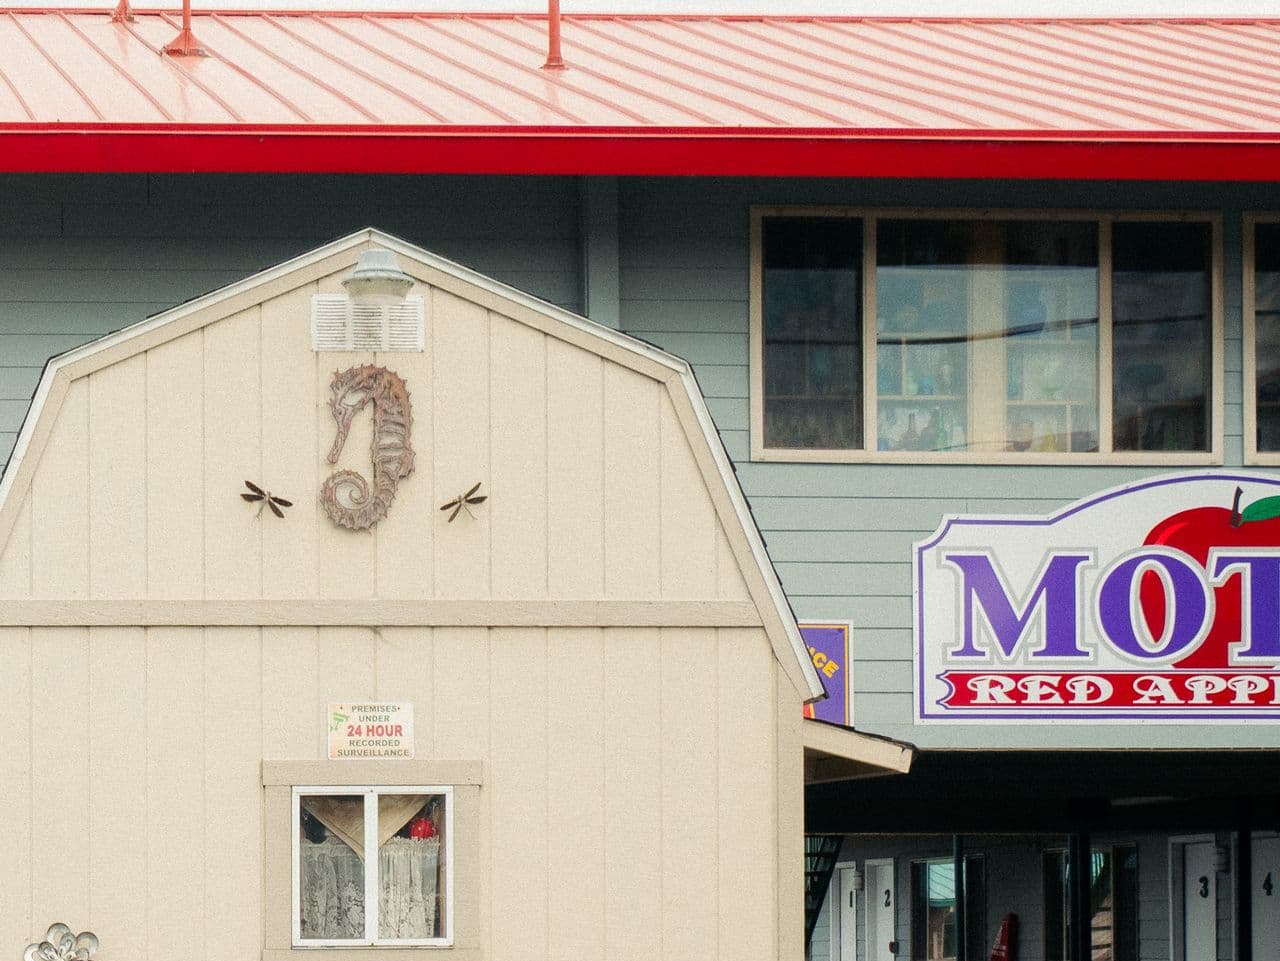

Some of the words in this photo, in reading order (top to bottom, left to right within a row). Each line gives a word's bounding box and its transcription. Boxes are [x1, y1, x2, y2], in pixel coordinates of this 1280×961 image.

[809, 647, 840, 679] CE
[966, 674, 1114, 705] RED
[1132, 674, 1280, 705] APP
[351, 705, 397, 713] PREMISES
[358, 715, 390, 723] UNDER
[347, 725, 363, 737] 24
[366, 725, 403, 737] HOUR
[349, 739, 400, 747] RECORDED
[337, 749, 410, 757] SURVEILLANCE
[1199, 875, 1209, 898] 3
[1262, 871, 1274, 896] 4
[884, 889, 891, 907] 2
